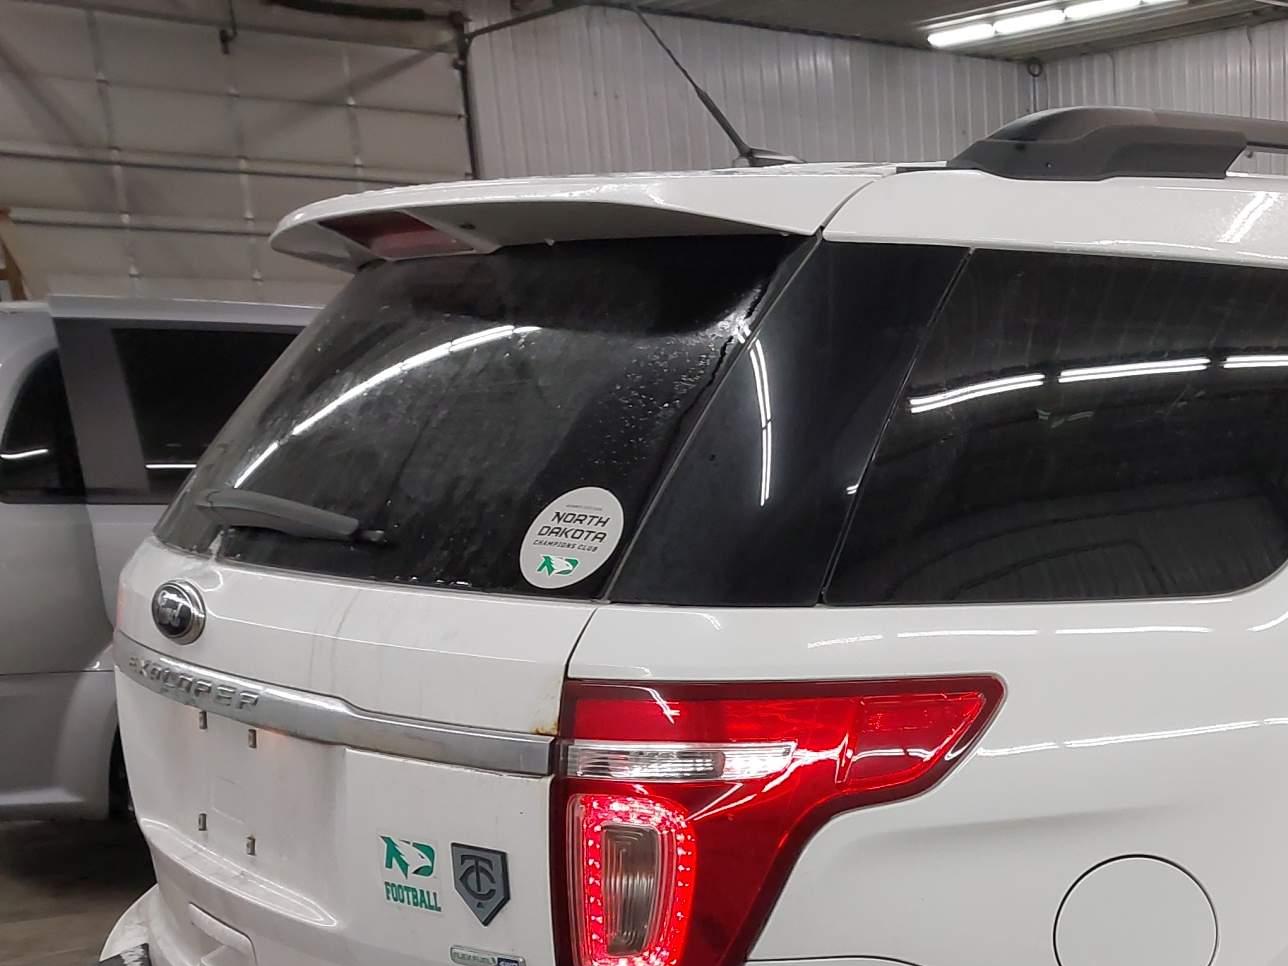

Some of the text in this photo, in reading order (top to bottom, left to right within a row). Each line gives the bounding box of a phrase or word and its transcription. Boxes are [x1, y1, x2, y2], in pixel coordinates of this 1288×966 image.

[551, 511, 611, 528] NORTH
[537, 525, 608, 543] DAKOTA
[533, 539, 599, 553] CHAMPIONS CLUB
[384, 881, 442, 912] FOOTBALL
